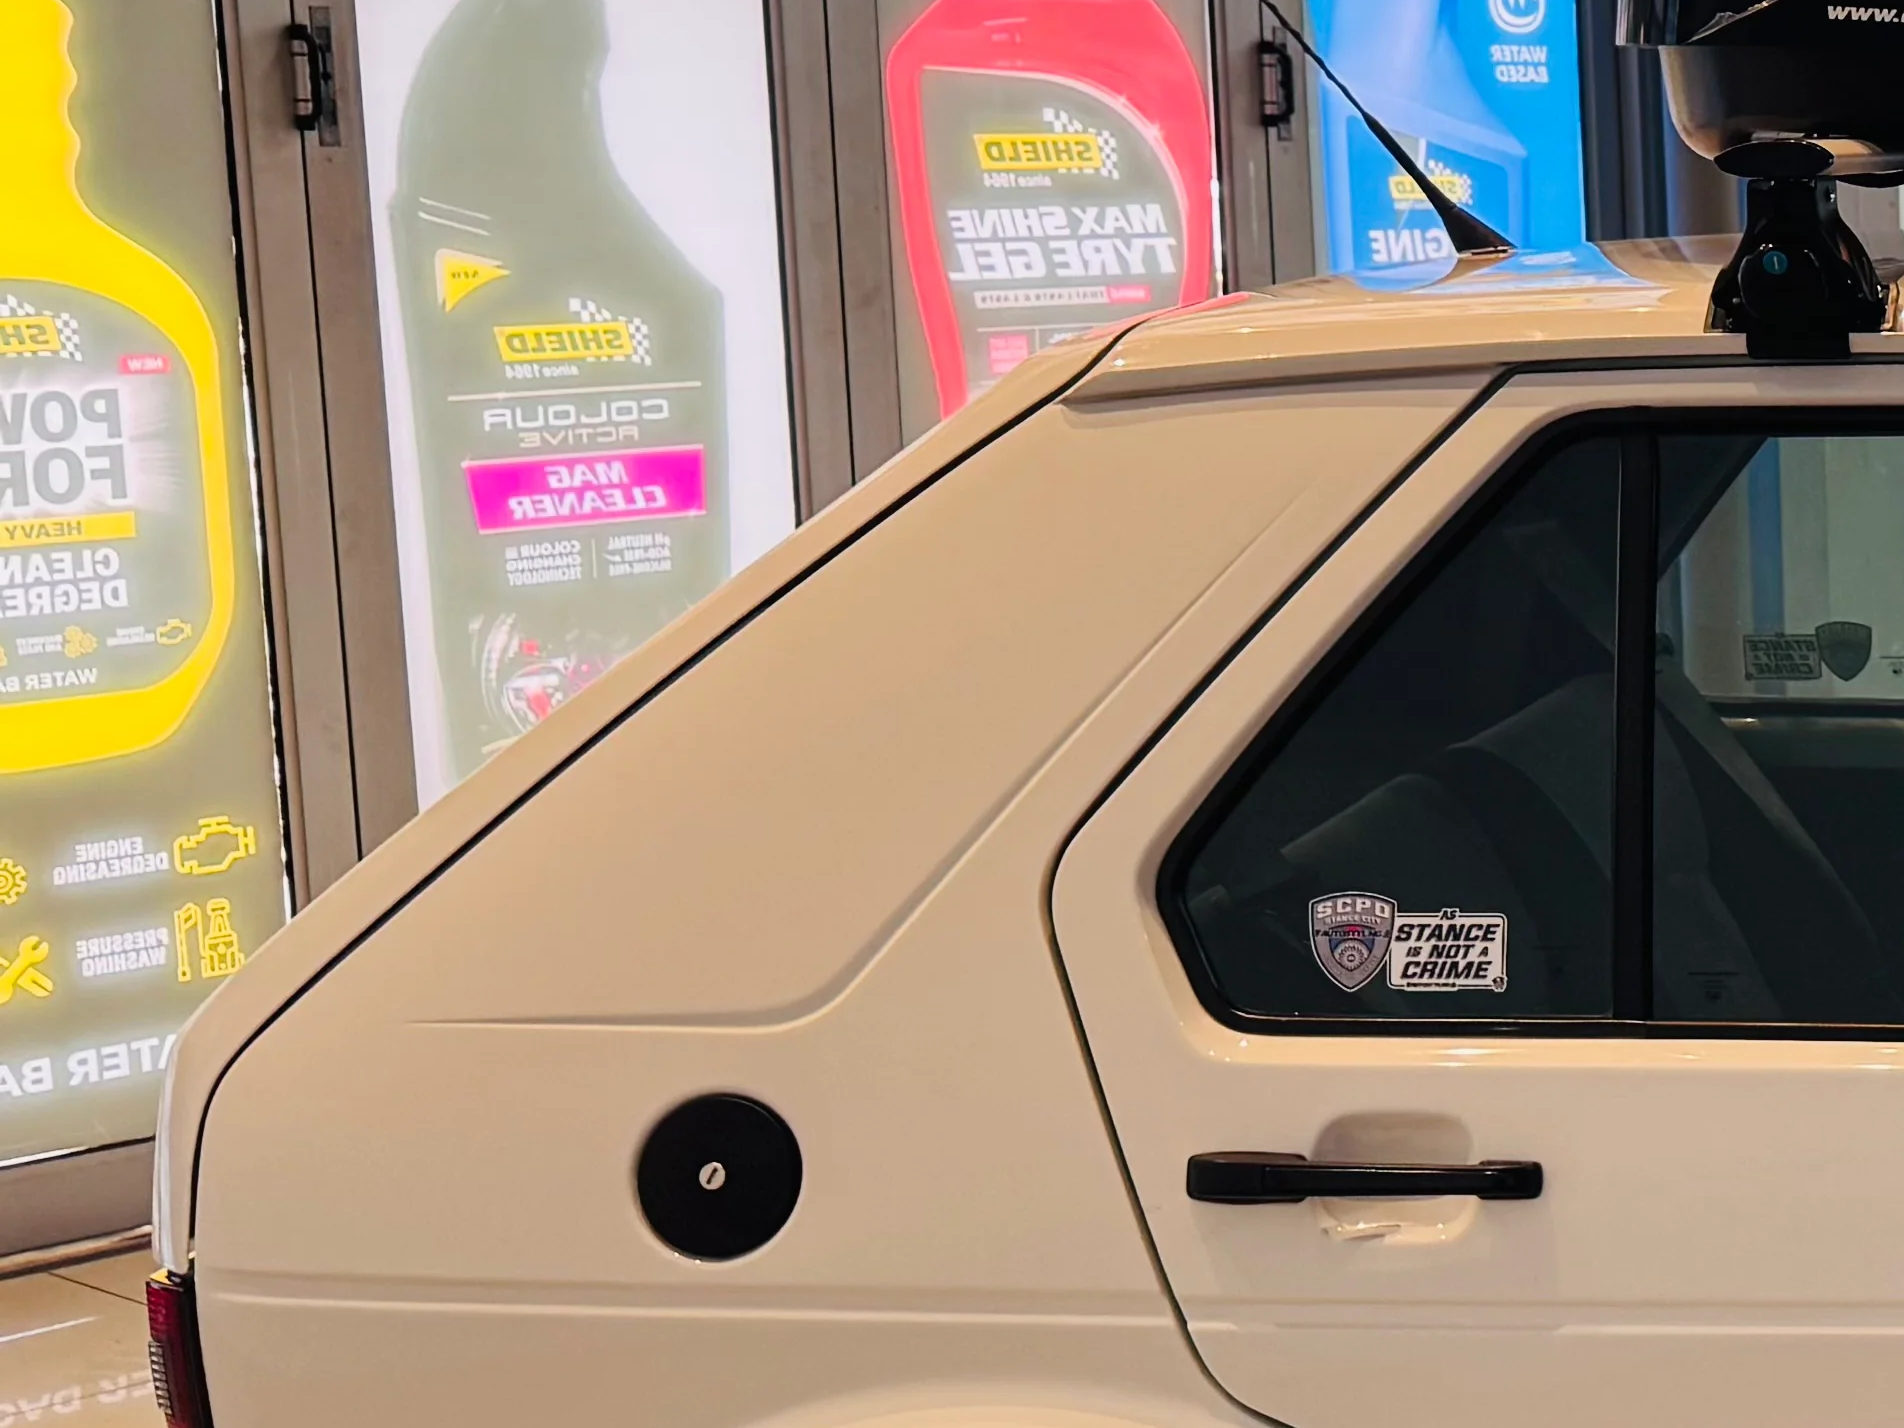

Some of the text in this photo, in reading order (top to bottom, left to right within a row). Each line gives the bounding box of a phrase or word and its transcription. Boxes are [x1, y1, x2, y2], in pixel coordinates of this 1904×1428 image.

[1317, 898, 1389, 919] SCPD
[1395, 923, 1500, 942] STANCE
[1405, 944, 1489, 959] IS NOT A
[1400, 960, 1492, 980] CRIME
